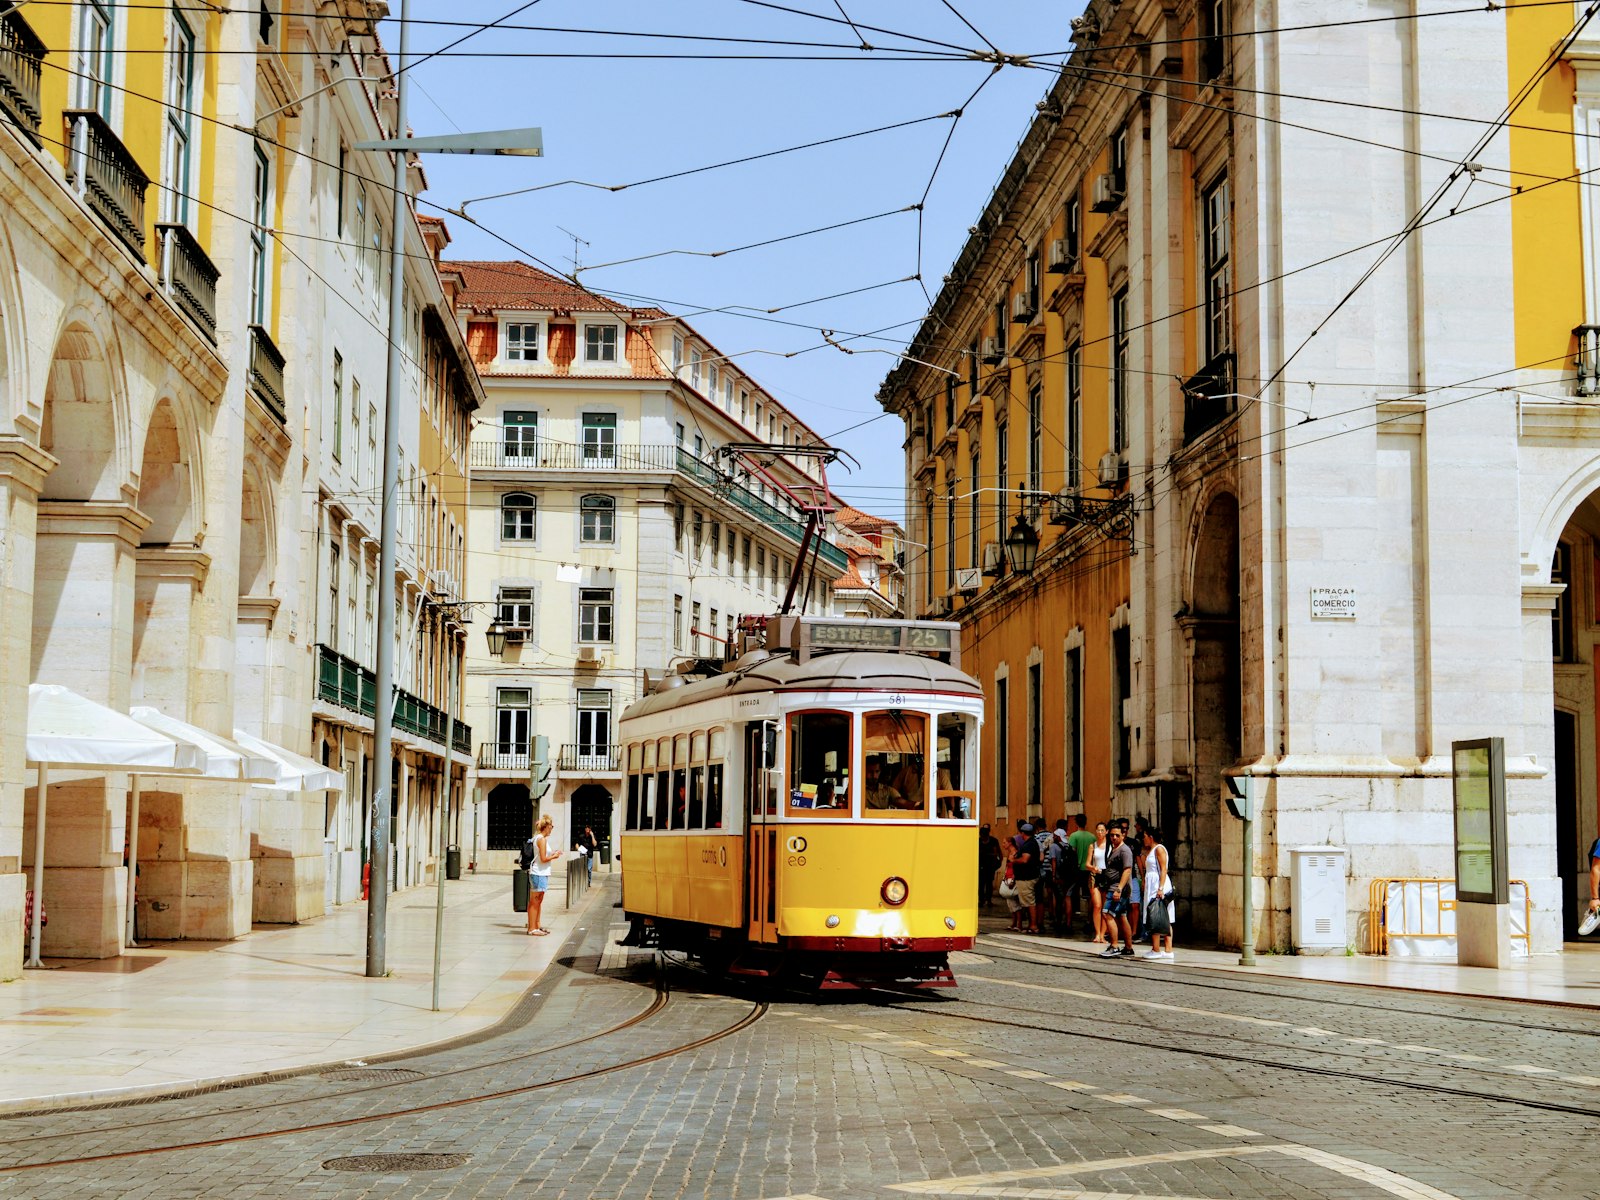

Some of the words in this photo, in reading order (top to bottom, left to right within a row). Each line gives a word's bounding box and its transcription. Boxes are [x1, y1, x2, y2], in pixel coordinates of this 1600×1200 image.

[815, 626, 893, 641] ESTRELA
[911, 629, 938, 646] 25
[889, 695, 906, 704] 581
